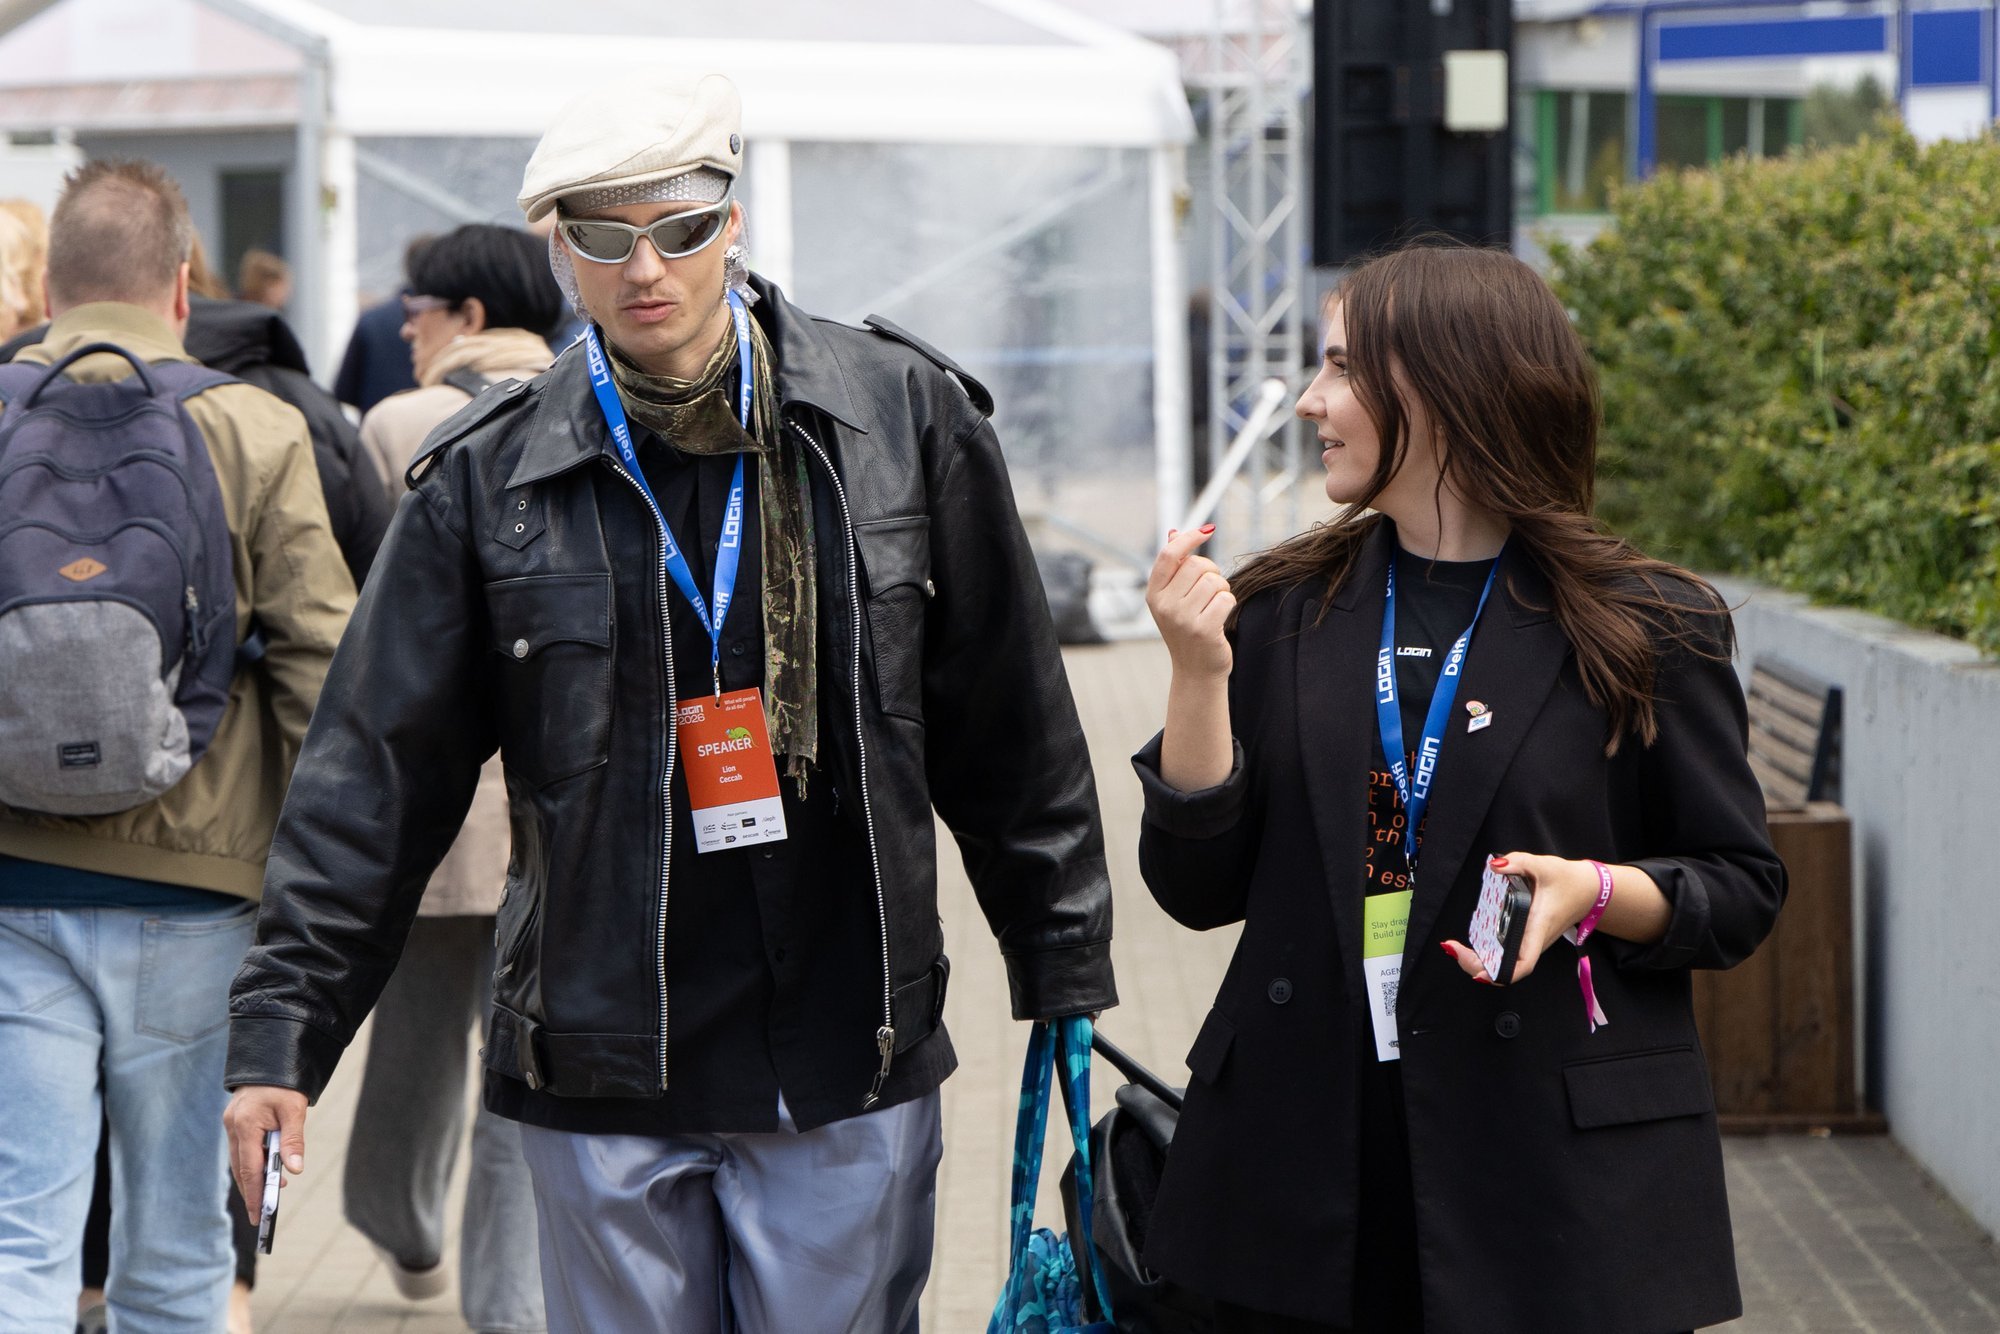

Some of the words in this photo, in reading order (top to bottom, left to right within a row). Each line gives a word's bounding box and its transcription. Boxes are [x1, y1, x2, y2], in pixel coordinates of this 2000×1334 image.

[613, 423, 634, 462] Delfi
[723, 487, 741, 548] LOGIN
[715, 591, 729, 630] Delfi
[1396, 647, 1432, 657] LOGIN
[1377, 647, 1394, 704] LOGIN
[676, 704, 704, 717] LOGIN
[698, 737, 752, 757] SPEAKER
[722, 765, 736, 773] Lion
[1391, 761, 1409, 803] Delfi
[1415, 736, 1440, 800] LOGIN
[1597, 866, 1611, 907] LOGIN
[1371, 921, 1388, 930] Slay
[1373, 929, 1394, 940] Build
